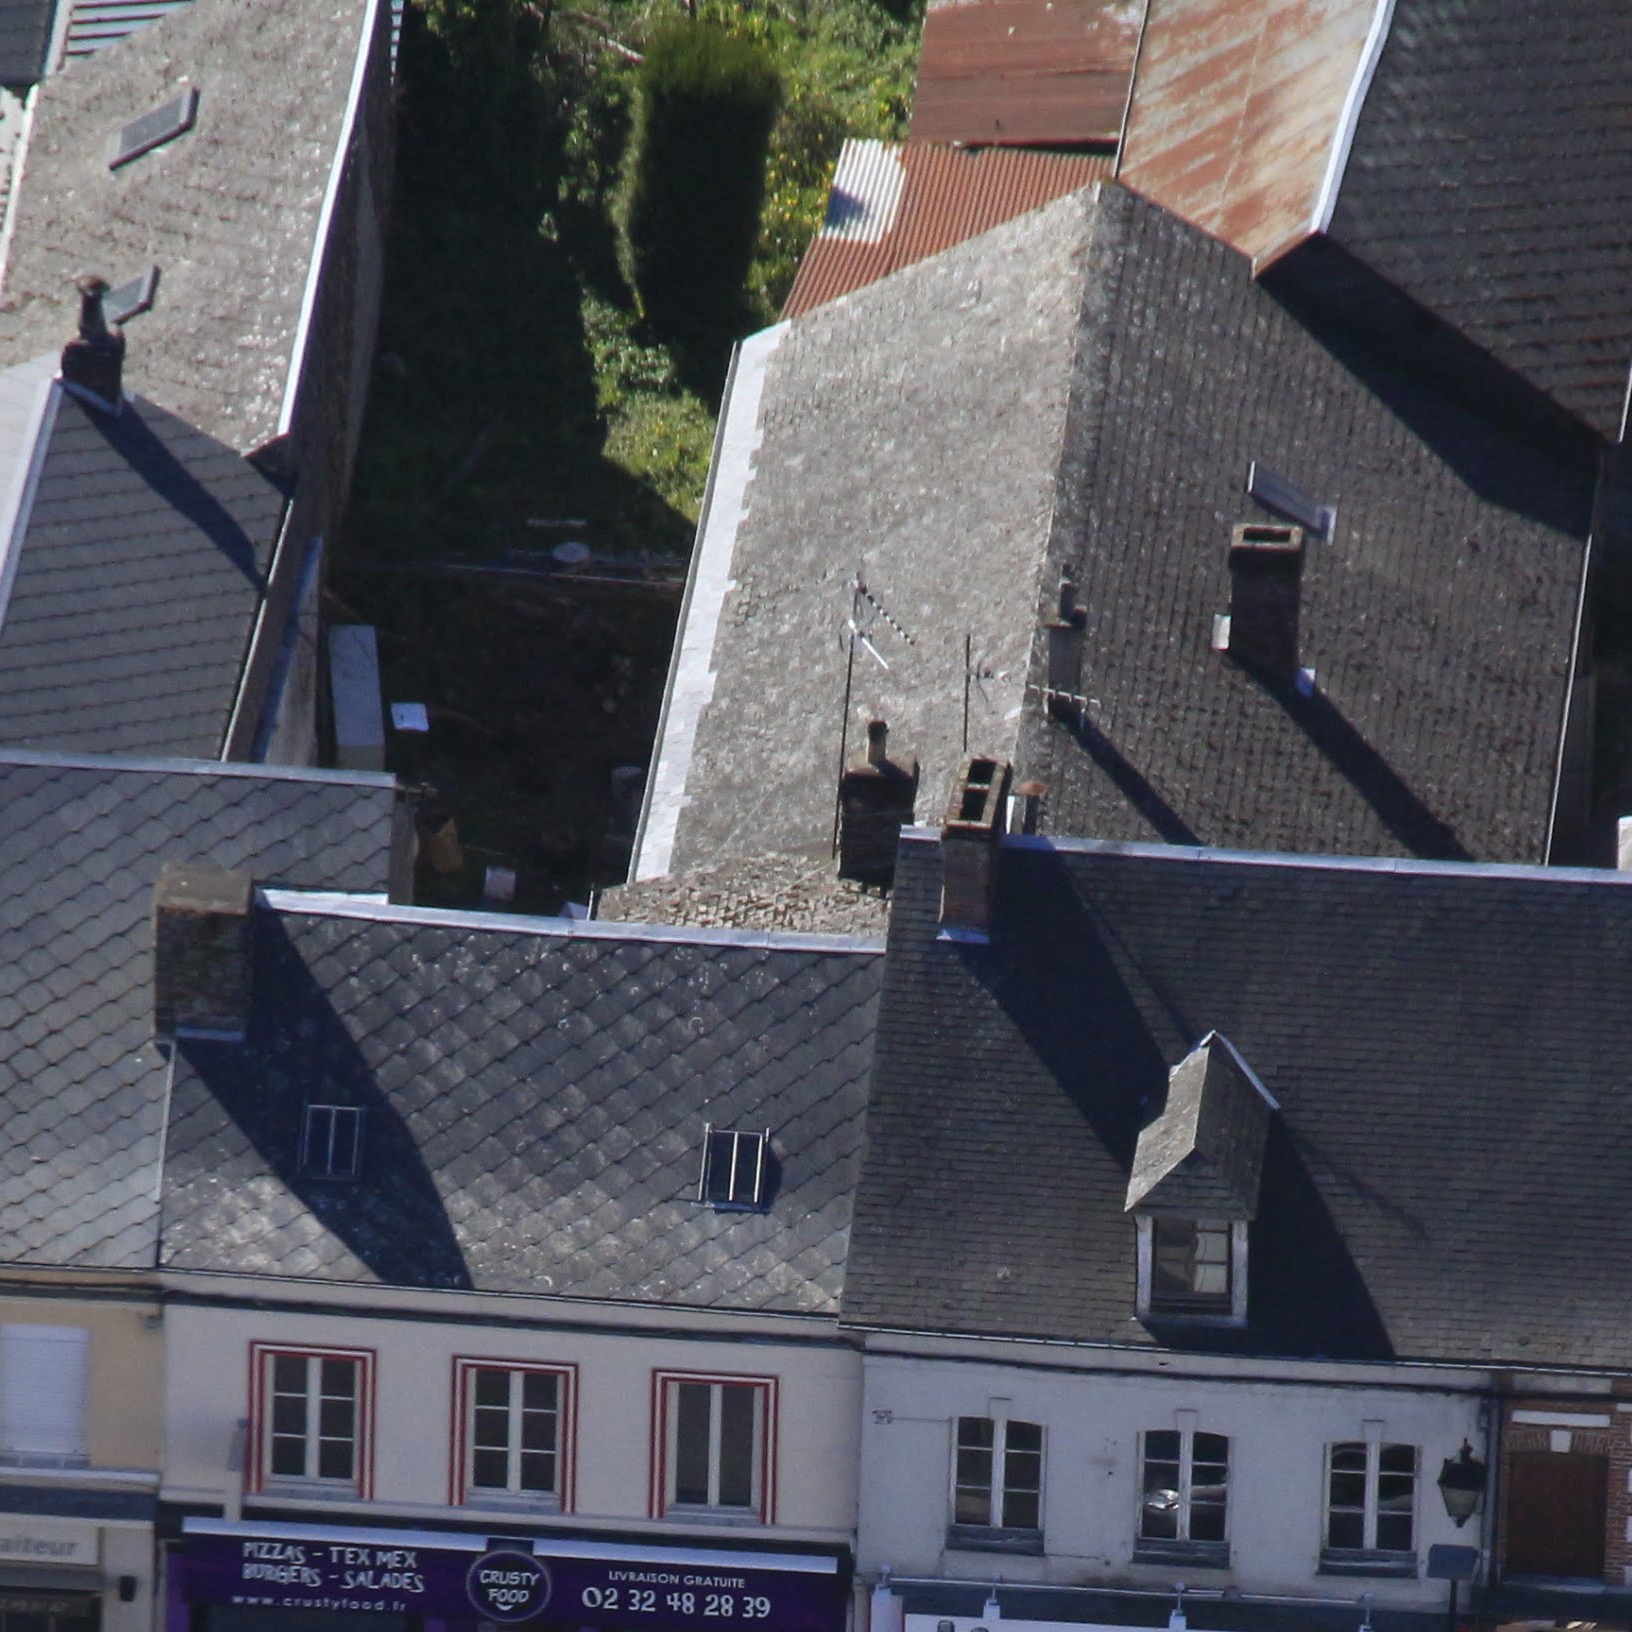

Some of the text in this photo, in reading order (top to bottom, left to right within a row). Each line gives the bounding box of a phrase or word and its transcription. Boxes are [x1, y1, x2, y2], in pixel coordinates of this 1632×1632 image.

[243, 1541, 306, 1566] PIZZAS
[329, 1546, 371, 1566] TEX
[375, 1551, 418, 1570] MEX
[241, 1563, 323, 1588] BURGERS
[340, 1570, 427, 1594] SALADES
[479, 1569, 540, 1587] CRUSTY
[608, 1569, 746, 1590] LIVRAISON GRATUITE
[231, 1595, 407, 1613] www.crustyfood.fr
[487, 1588, 530, 1604] FOOD
[581, 1585, 772, 1619] 02 32 48 28 39
